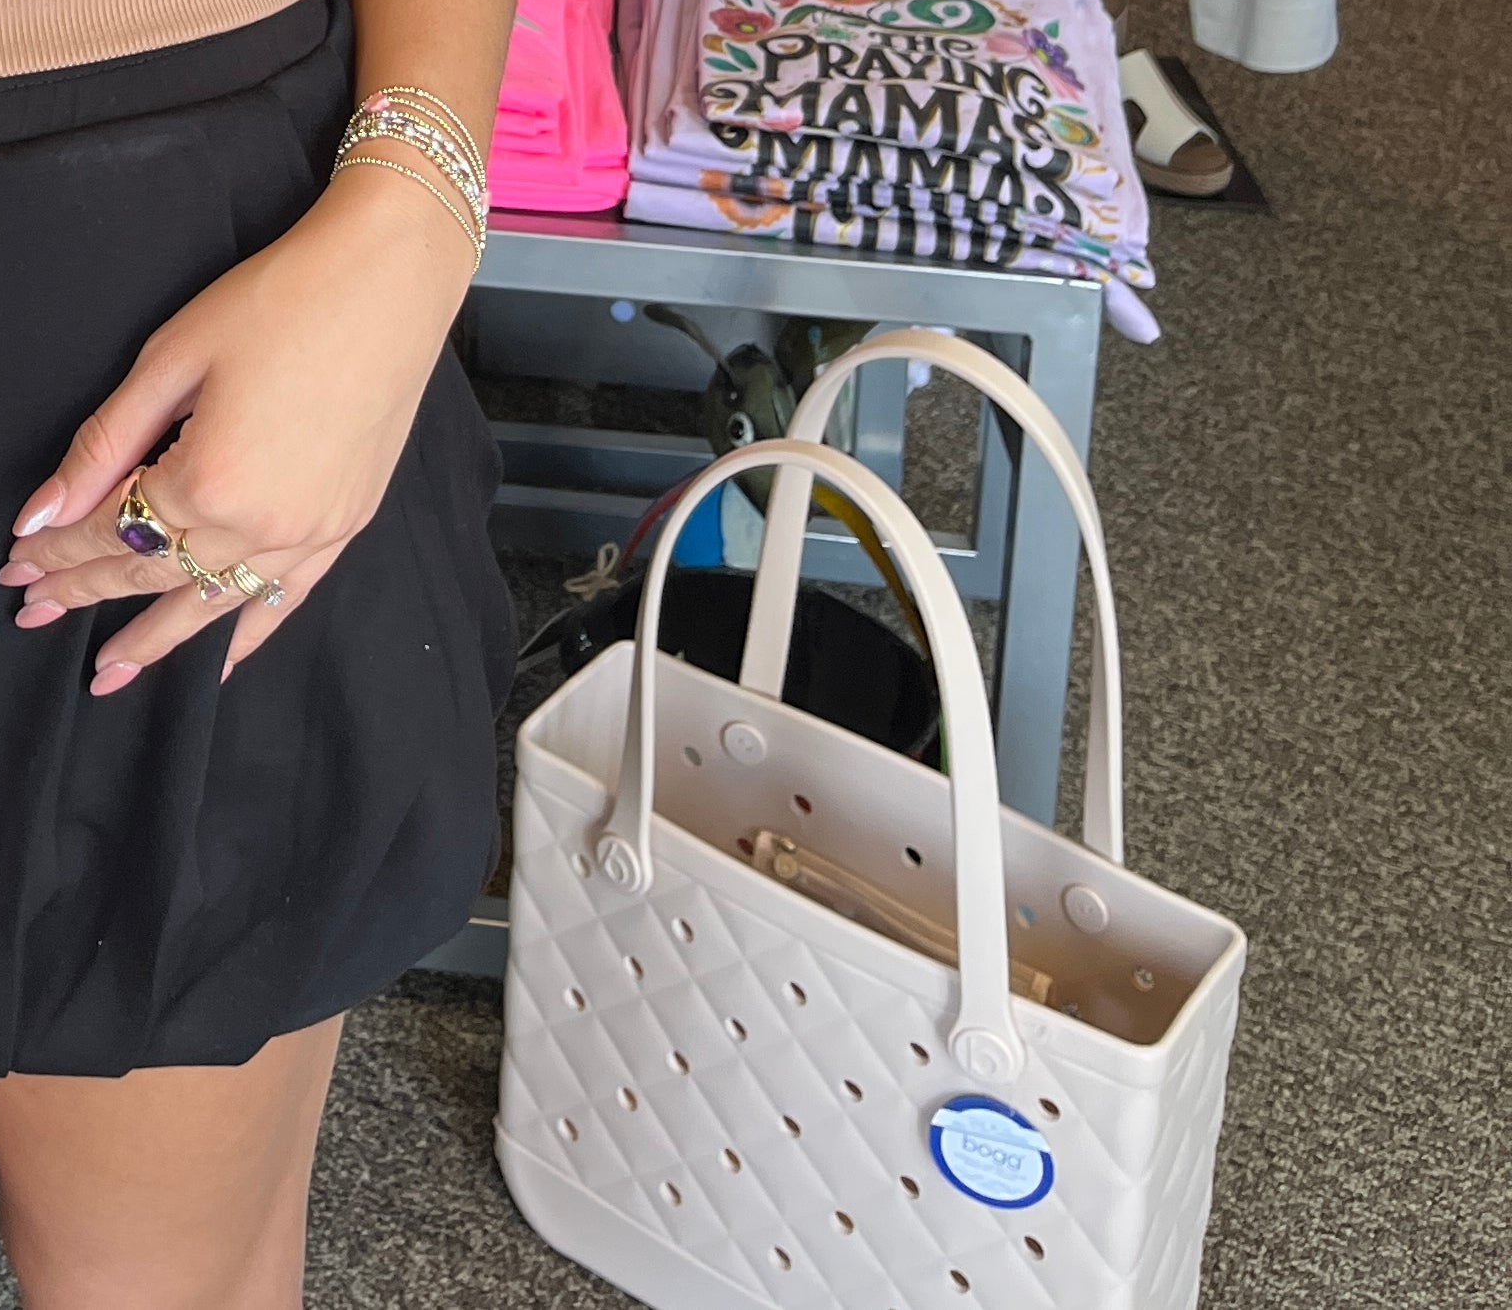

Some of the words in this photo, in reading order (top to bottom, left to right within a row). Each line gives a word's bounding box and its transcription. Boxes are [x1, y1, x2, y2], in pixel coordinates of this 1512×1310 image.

[757, 34, 1051, 119] PRAYING
[702, 76, 1073, 183] MAMAS
[962, 1131, 1021, 1173] bogg
